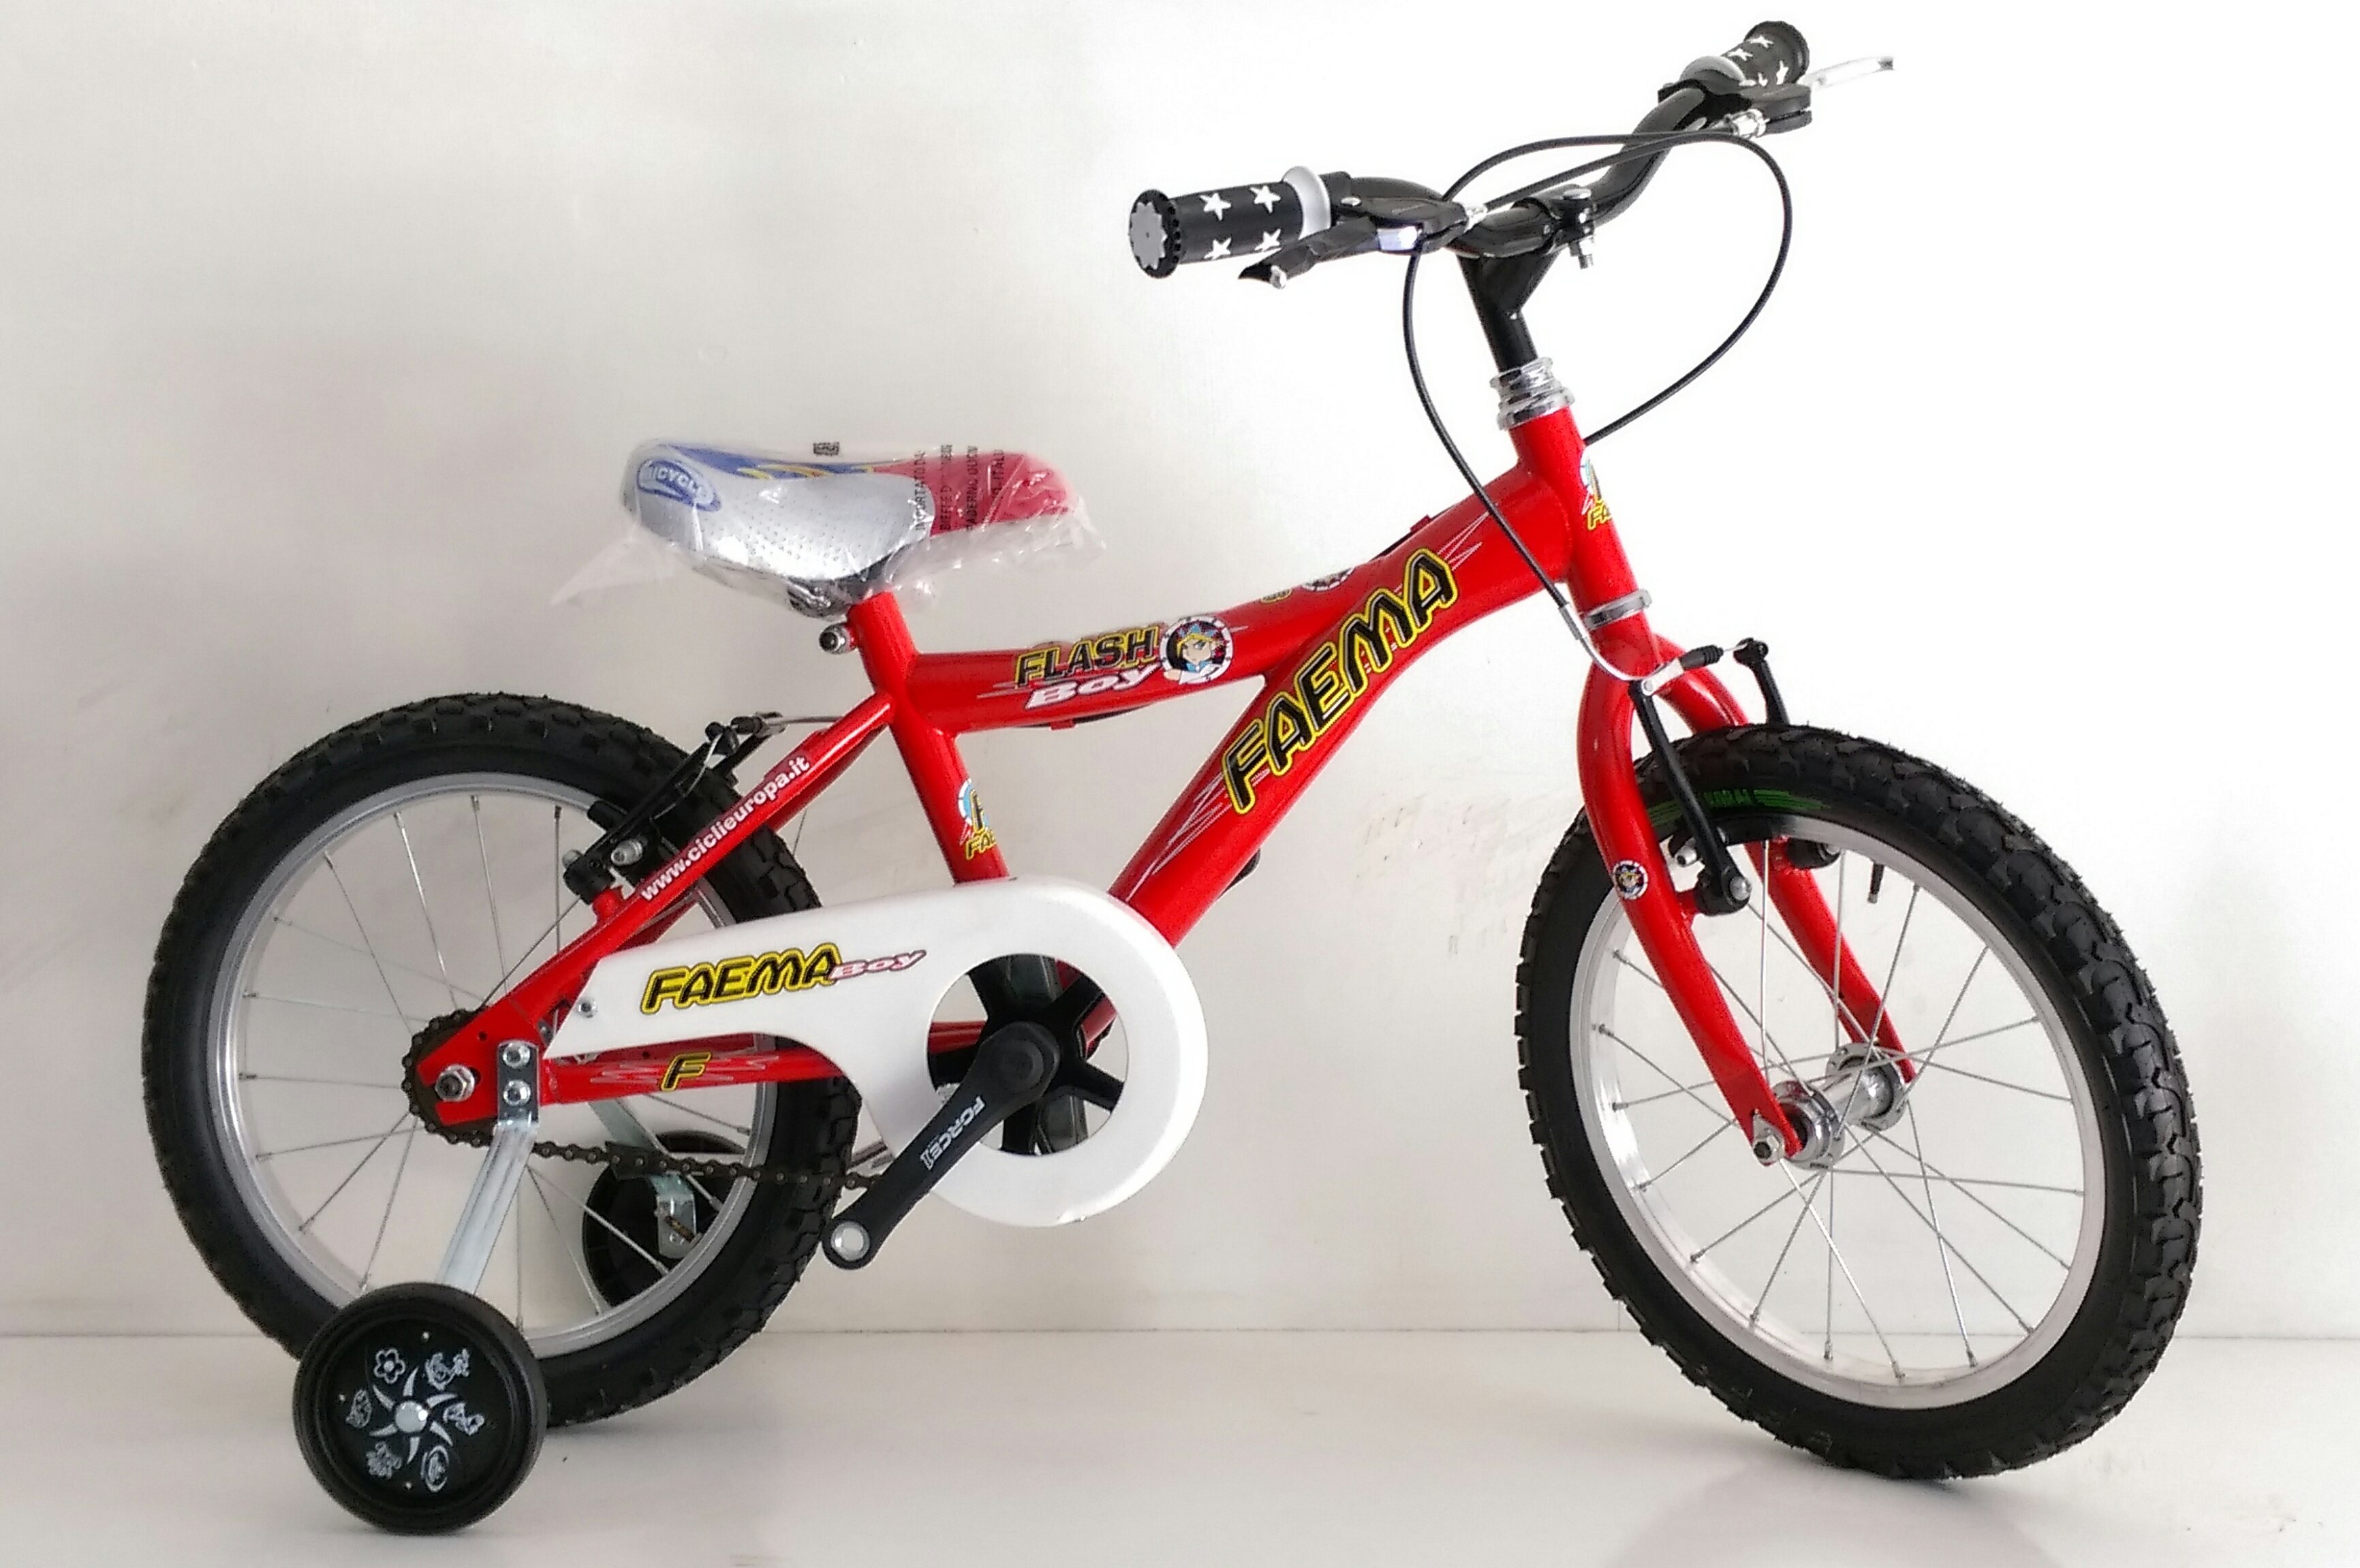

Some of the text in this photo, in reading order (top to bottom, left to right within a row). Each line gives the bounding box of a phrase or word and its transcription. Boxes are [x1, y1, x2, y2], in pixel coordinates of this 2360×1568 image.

[1014, 624, 1160, 689] FLASH
[1222, 548, 1459, 815] FAEMA
[641, 756, 810, 900] www.ciclieuropa.it
[640, 942, 843, 1014] FAEMA
[660, 1052, 712, 1091] F
